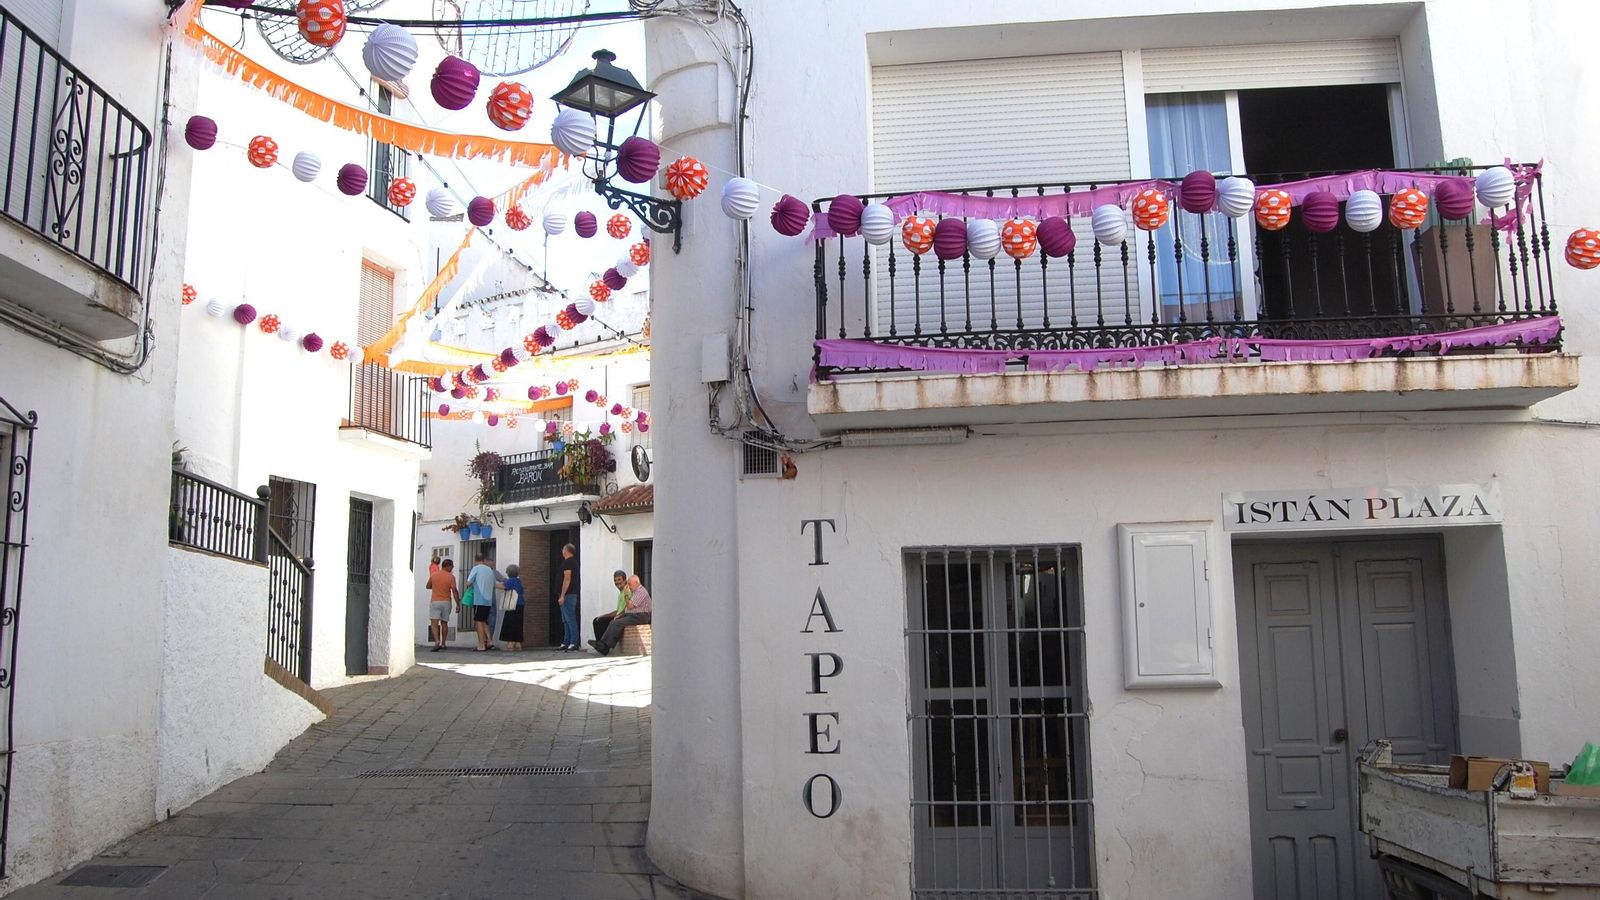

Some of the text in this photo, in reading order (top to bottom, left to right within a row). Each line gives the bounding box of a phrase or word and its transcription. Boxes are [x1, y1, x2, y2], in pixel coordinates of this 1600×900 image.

[1235, 494, 1492, 524] ISTÁN PLAZA
[800, 519, 844, 818] TAPEO
